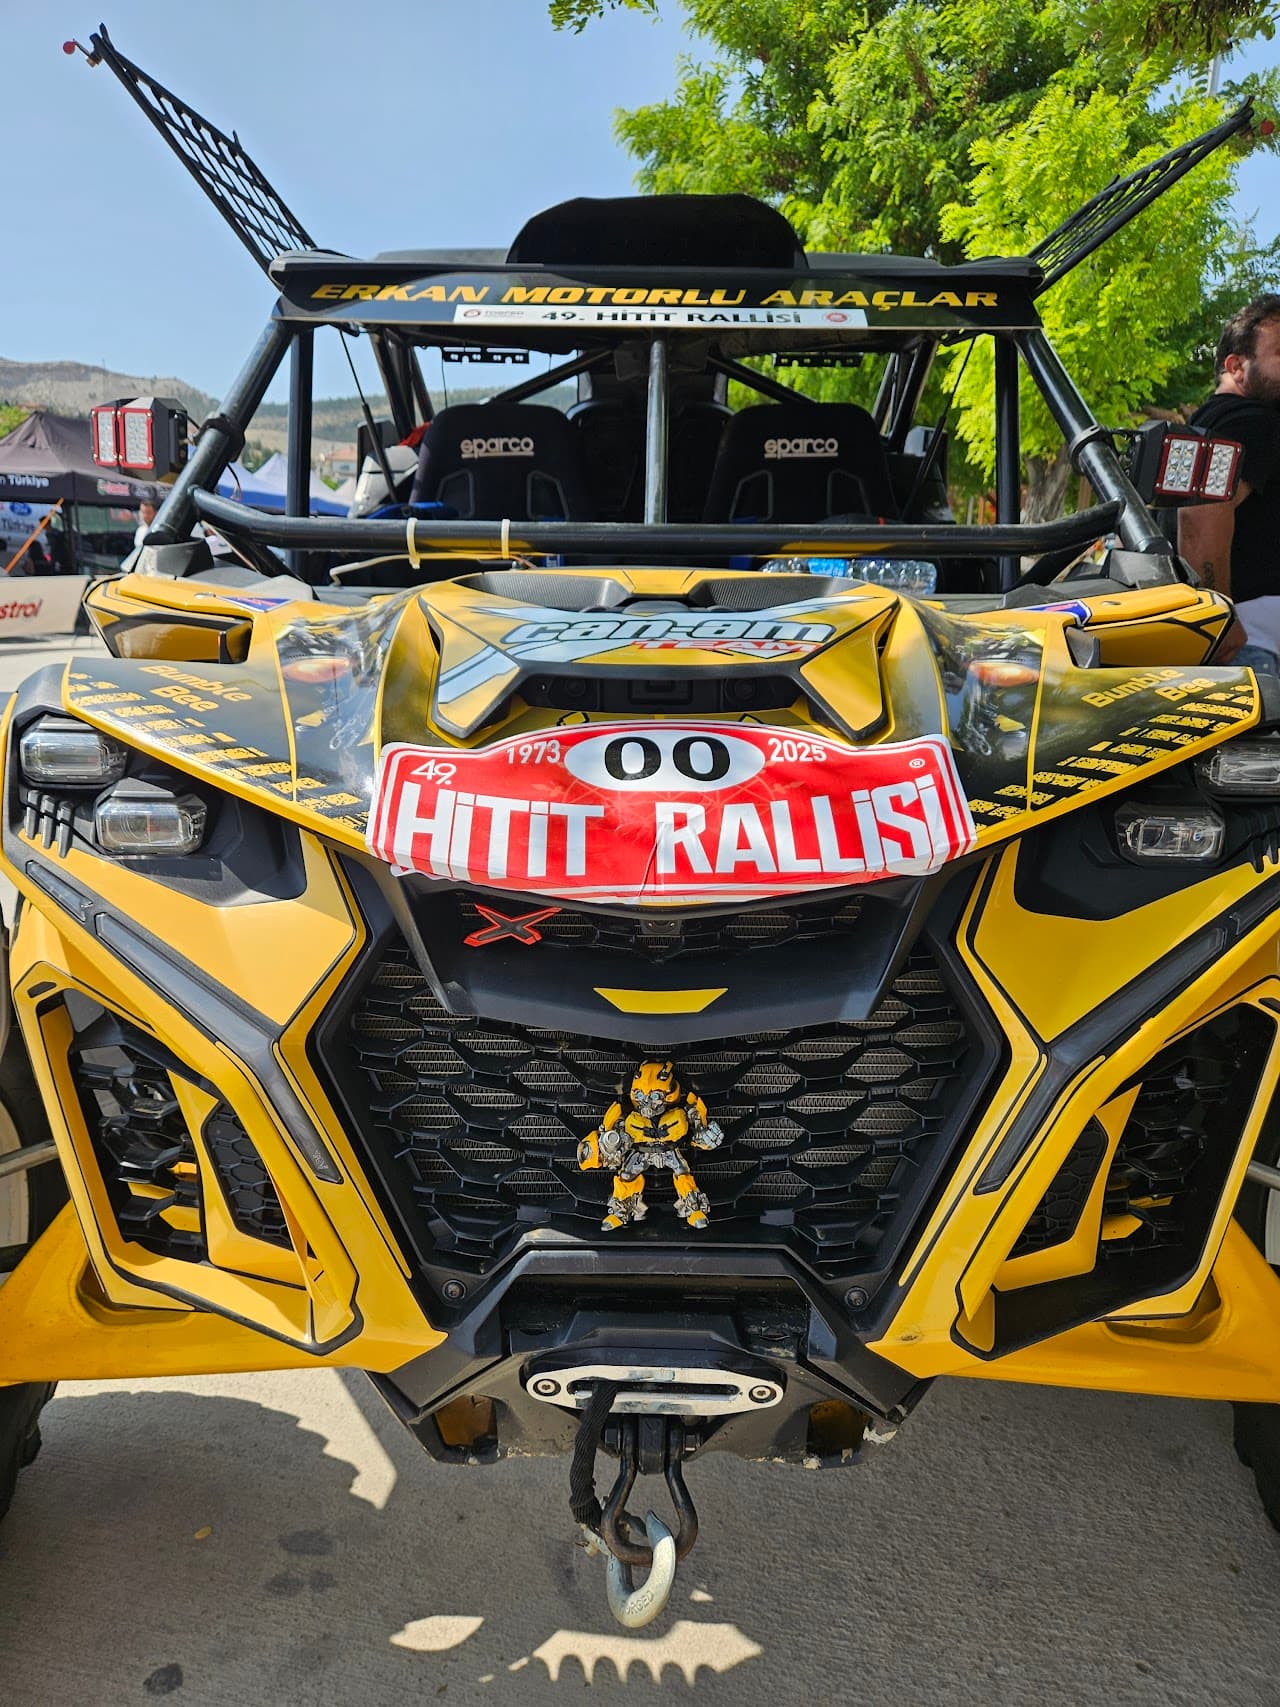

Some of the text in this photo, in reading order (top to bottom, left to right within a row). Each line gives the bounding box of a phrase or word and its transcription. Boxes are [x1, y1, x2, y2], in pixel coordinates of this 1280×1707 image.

[311, 284, 998, 311] ERKAN MOTORLU ARAÇLAR
[541, 311, 585, 321] 49.
[460, 437, 534, 459] sparco
[764, 438, 838, 459] sparco
[500, 619, 836, 642] can-am
[632, 640, 823, 652] TEAM
[138, 665, 253, 702] Bumble
[1081, 669, 1184, 708] Bumble
[1155, 678, 1216, 701] Bee
[150, 685, 219, 712] Bee
[506, 740, 561, 765] 1973
[604, 736, 731, 782] 00
[767, 738, 827, 763] 2025
